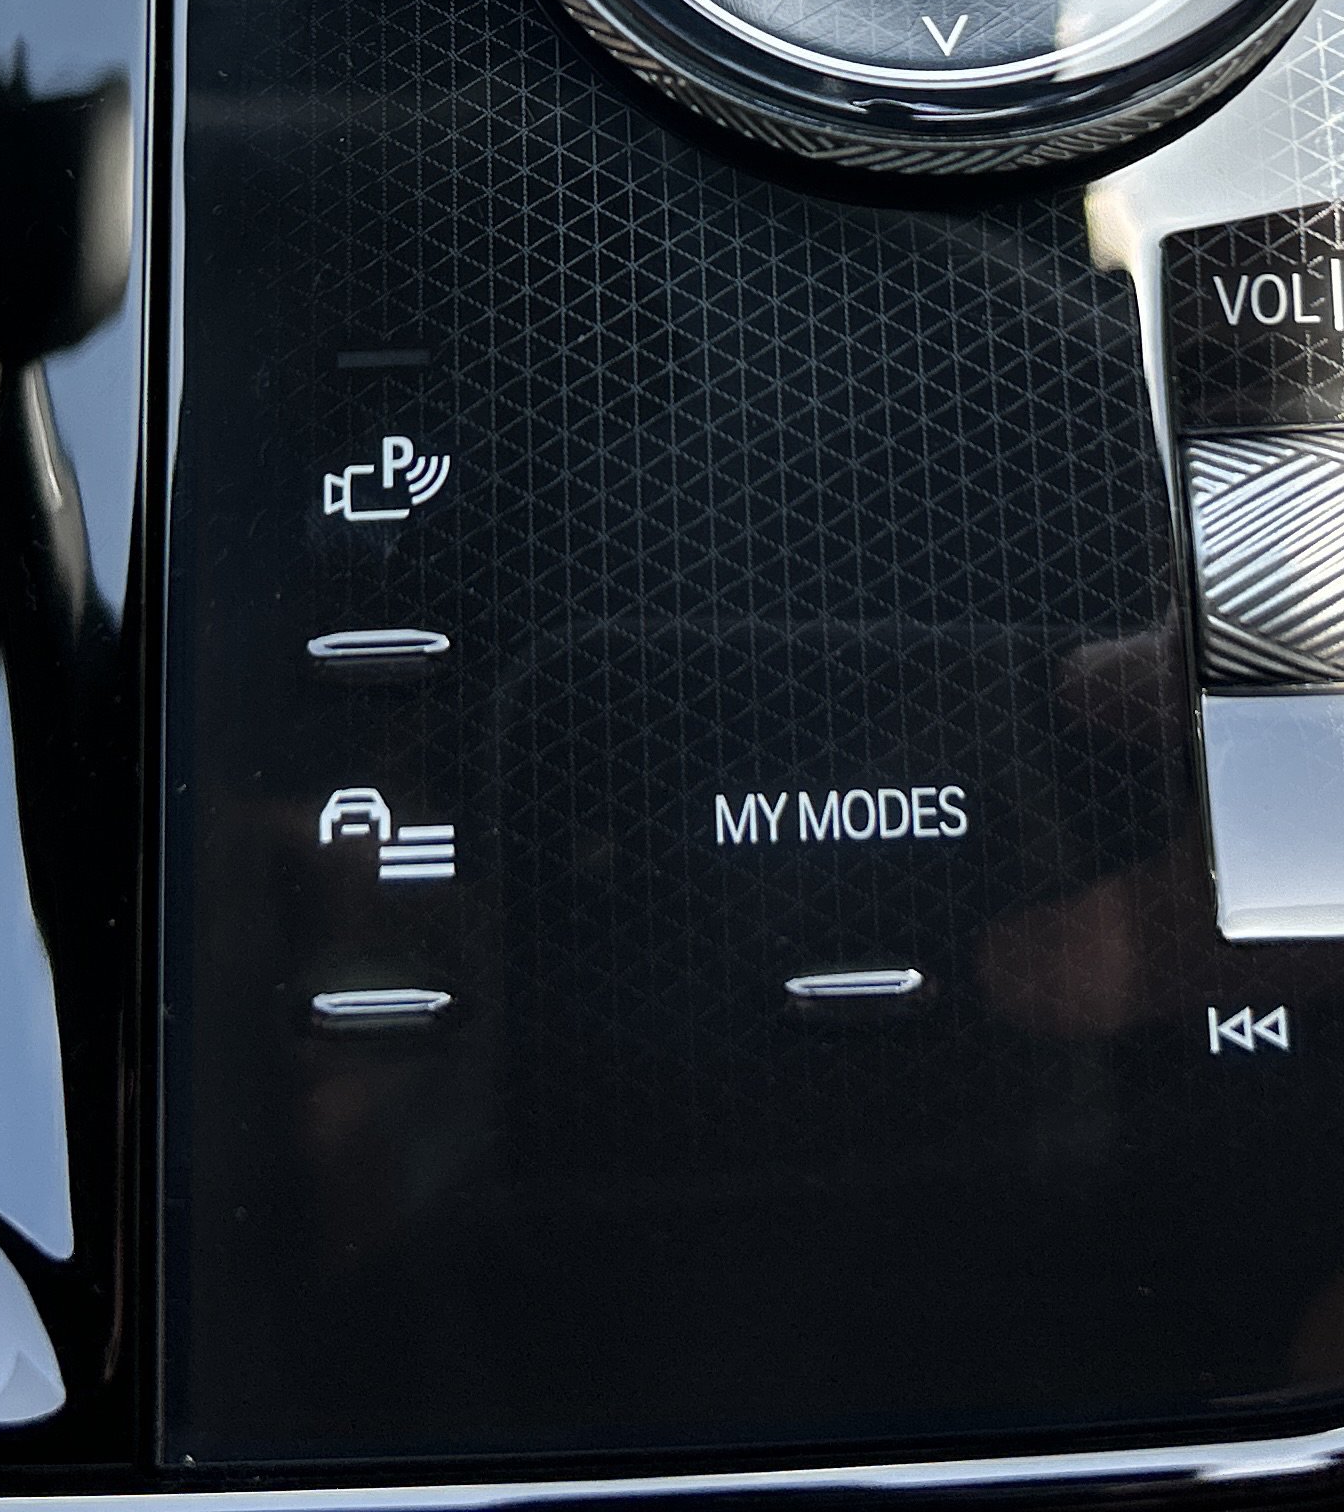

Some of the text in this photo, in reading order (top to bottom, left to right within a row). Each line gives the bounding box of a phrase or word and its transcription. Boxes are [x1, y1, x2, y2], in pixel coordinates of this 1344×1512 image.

[1213, 273, 1320, 327] VOL
[715, 785, 968, 845] MY MODES
